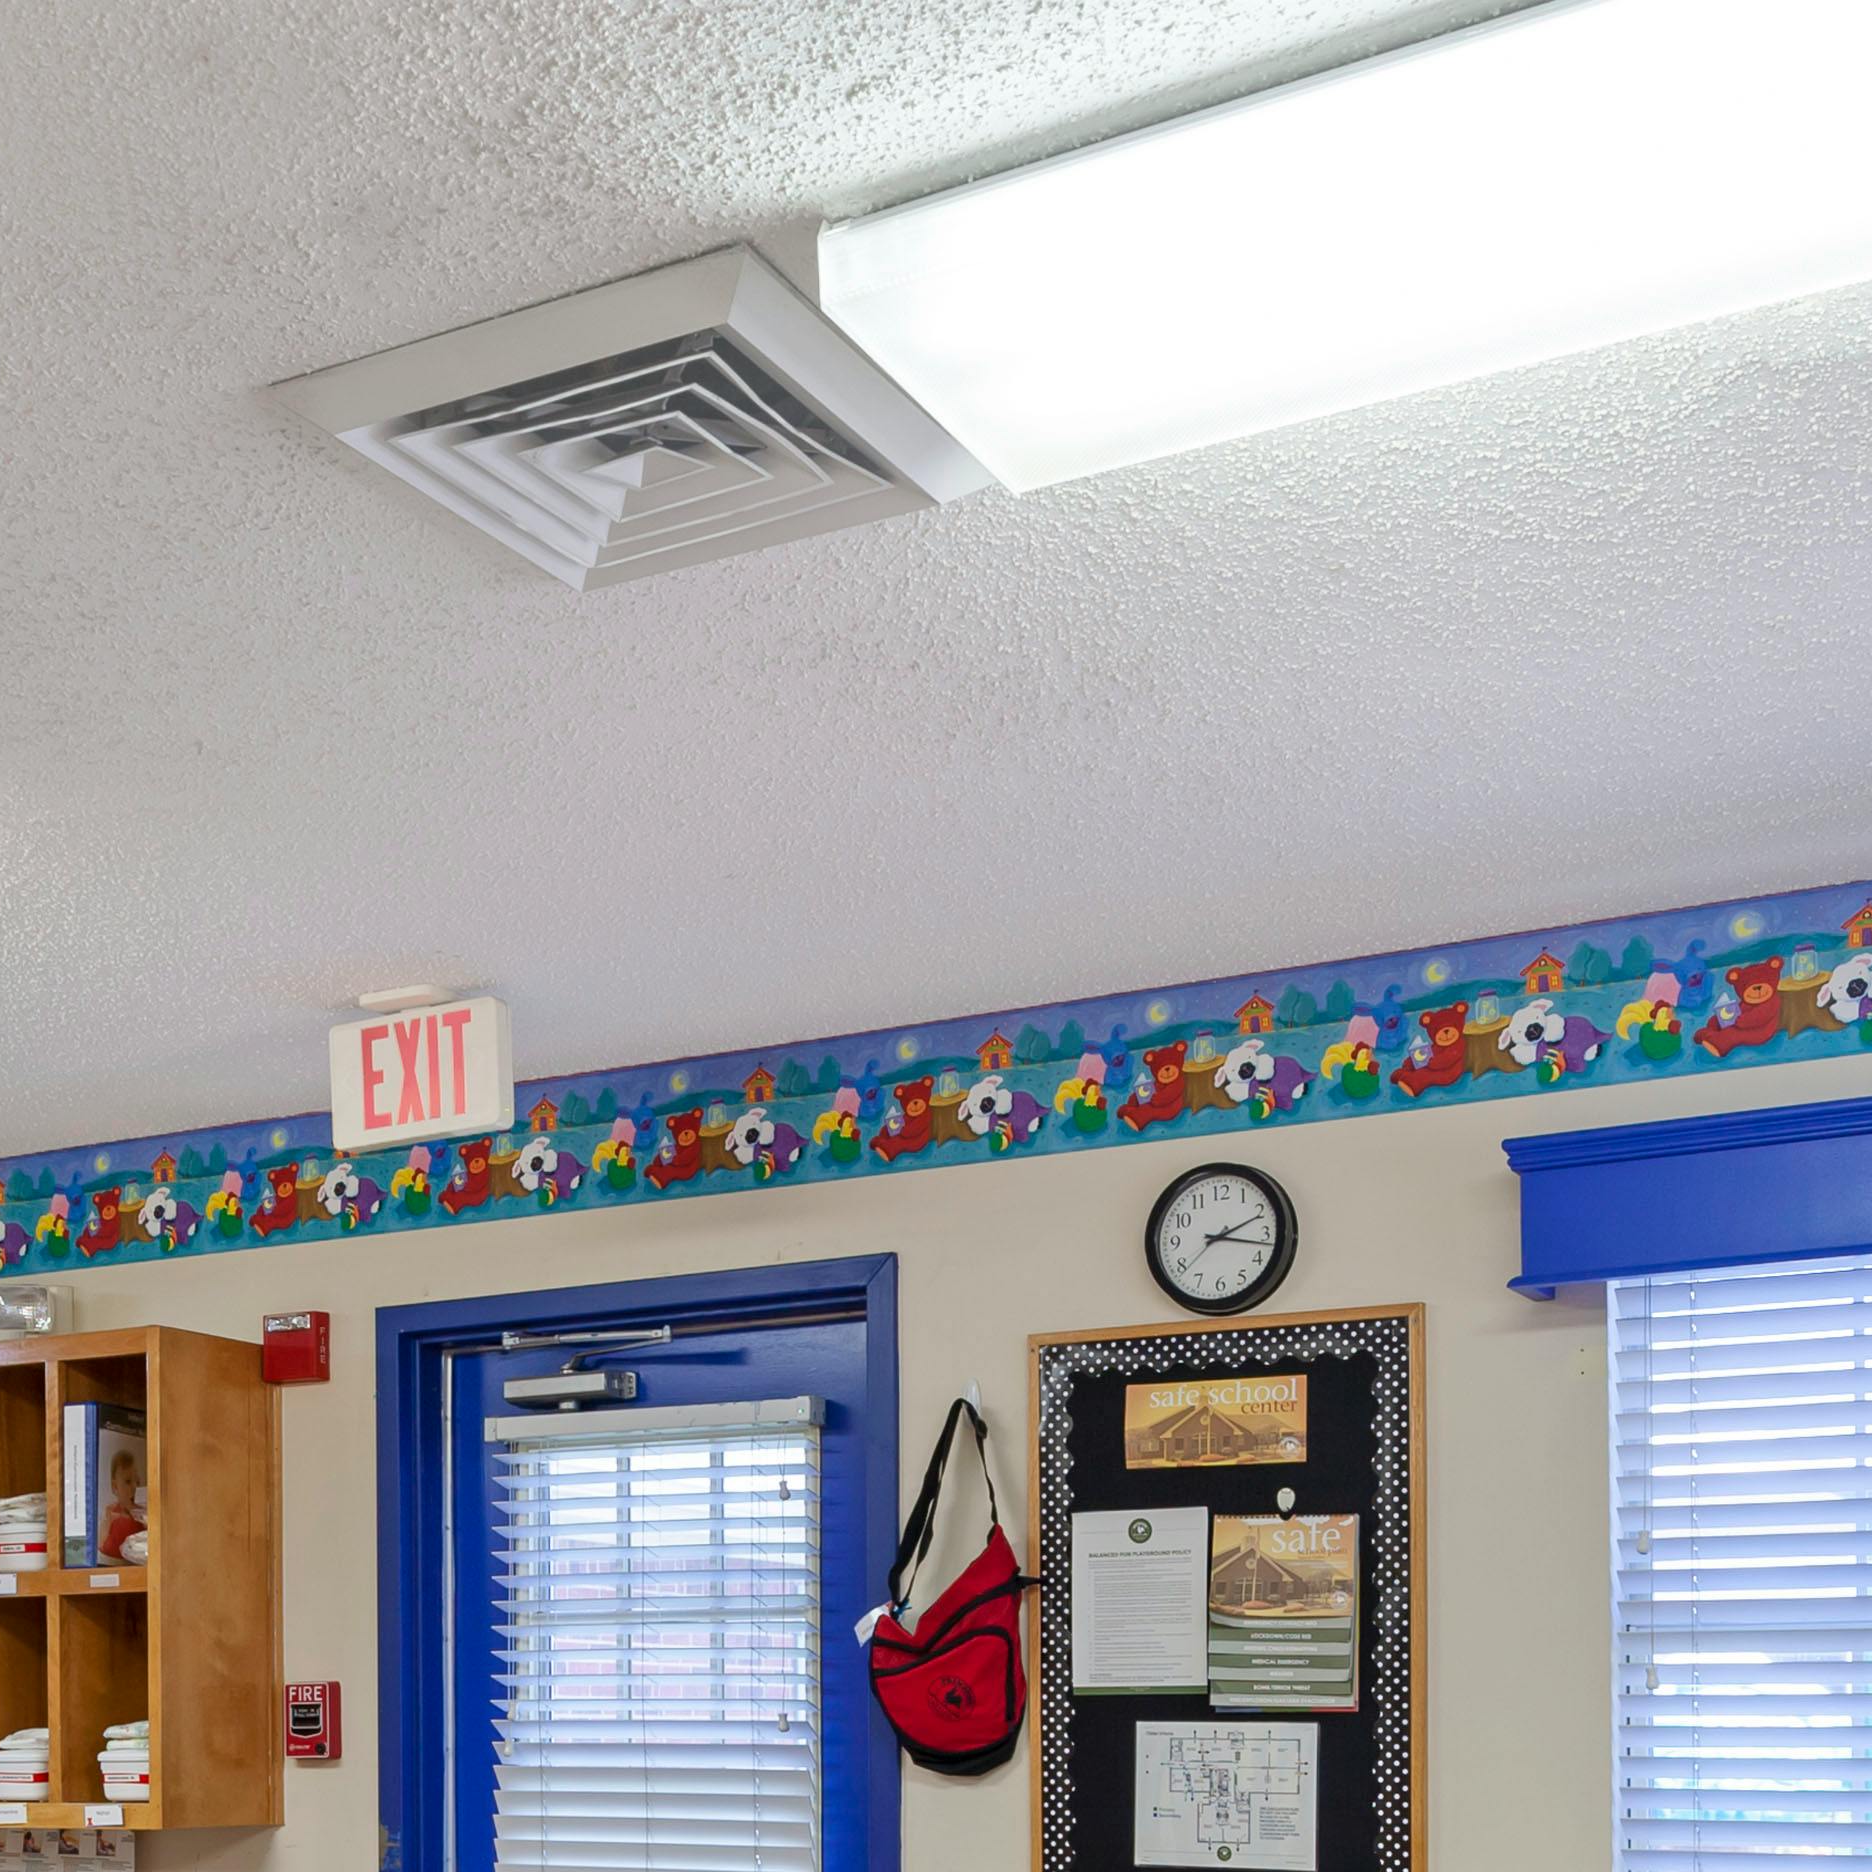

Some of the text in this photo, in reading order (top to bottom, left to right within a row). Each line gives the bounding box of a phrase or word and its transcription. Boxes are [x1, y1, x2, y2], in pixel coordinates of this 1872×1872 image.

[361, 1008, 471, 1130] EXIT
[1213, 1184, 1230, 1201] 12
[1240, 1188, 1246, 1204] 1
[1192, 1194, 1204, 1210] 11
[1255, 1203, 1264, 1219] 2
[1176, 1212, 1191, 1228] 10
[1261, 1226, 1270, 1242] 3
[1170, 1235, 1181, 1250] 9
[1177, 1257, 1187, 1273] 8
[1252, 1250, 1263, 1266] 4
[1194, 1273, 1203, 1289] 7
[1215, 1275, 1226, 1292] 6
[1237, 1269, 1247, 1285] 5
[1149, 1378, 1298, 1409] safe school
[1241, 1400, 1298, 1415] center
[1271, 1523, 1341, 1553] safe
[289, 1686, 323, 1702] FIRE
